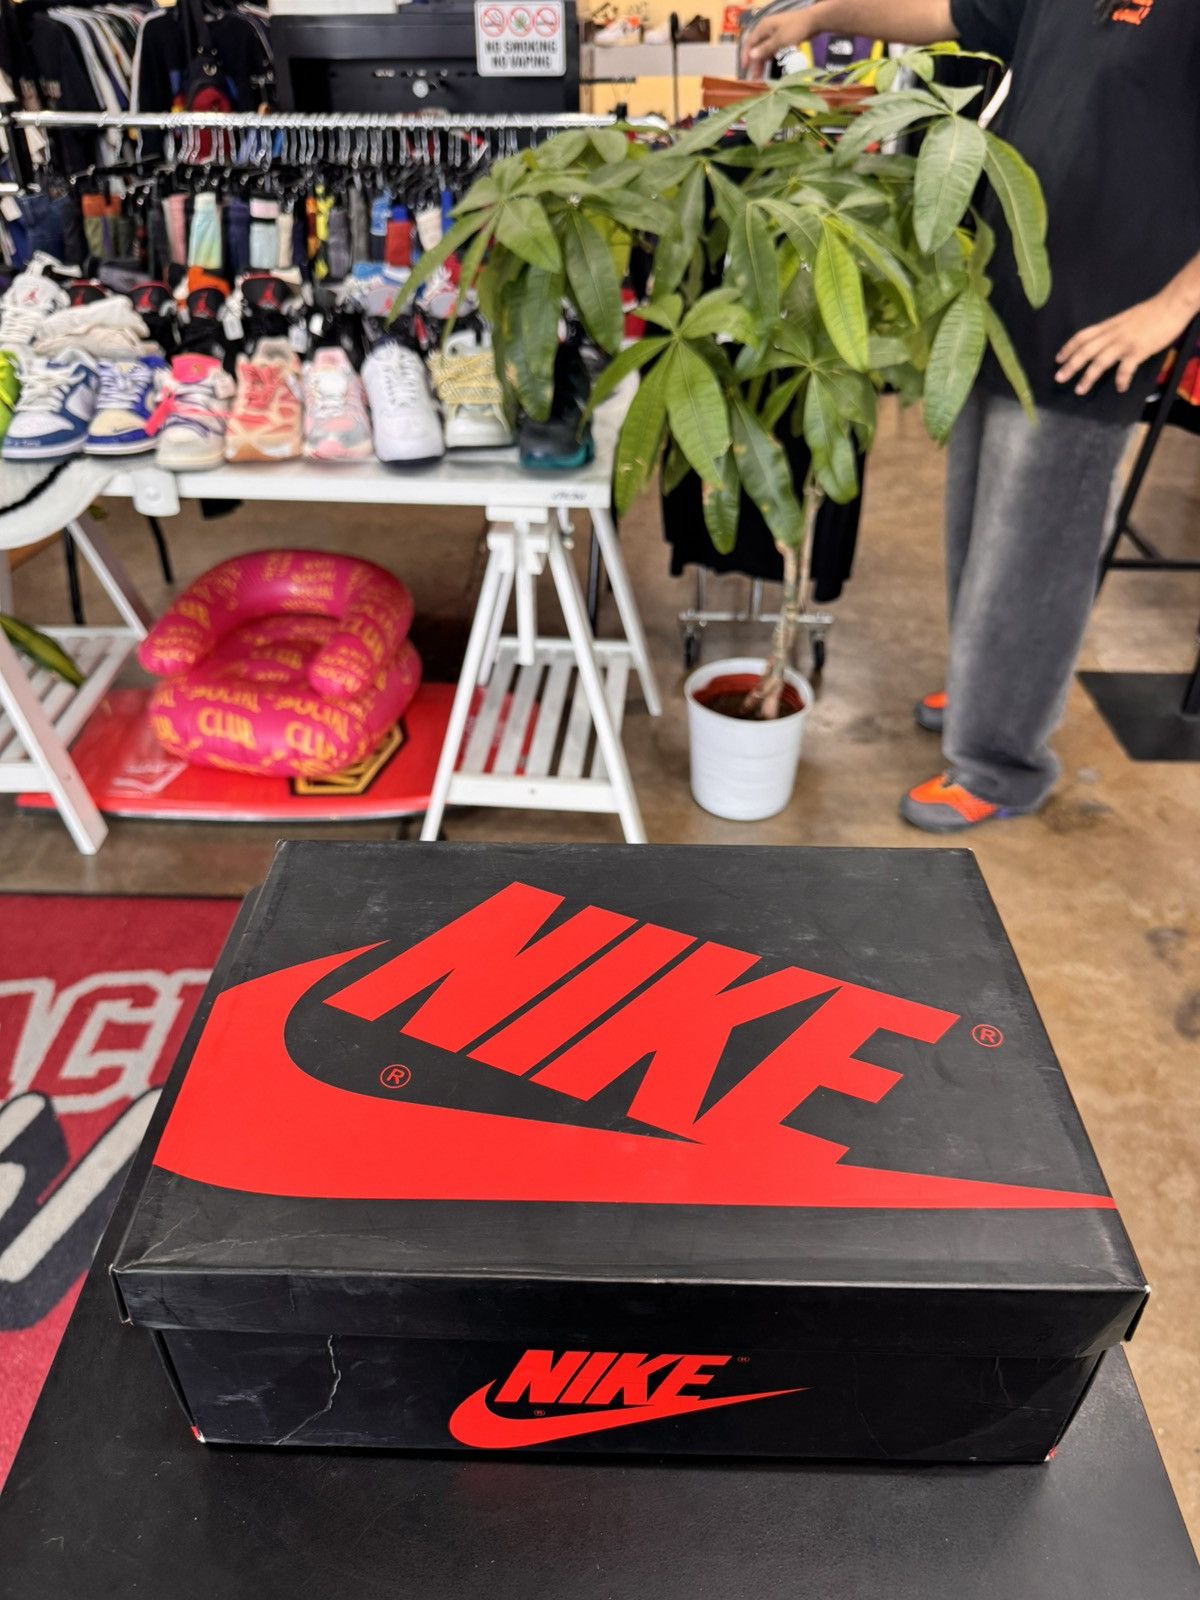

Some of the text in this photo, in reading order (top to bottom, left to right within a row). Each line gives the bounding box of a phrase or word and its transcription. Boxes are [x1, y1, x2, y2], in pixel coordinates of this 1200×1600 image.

[485, 41, 557, 53] NO SMOKING
[492, 56, 506, 68] NO
[323, 881, 960, 1165] NIKE
[494, 1349, 732, 1406] NIKE
